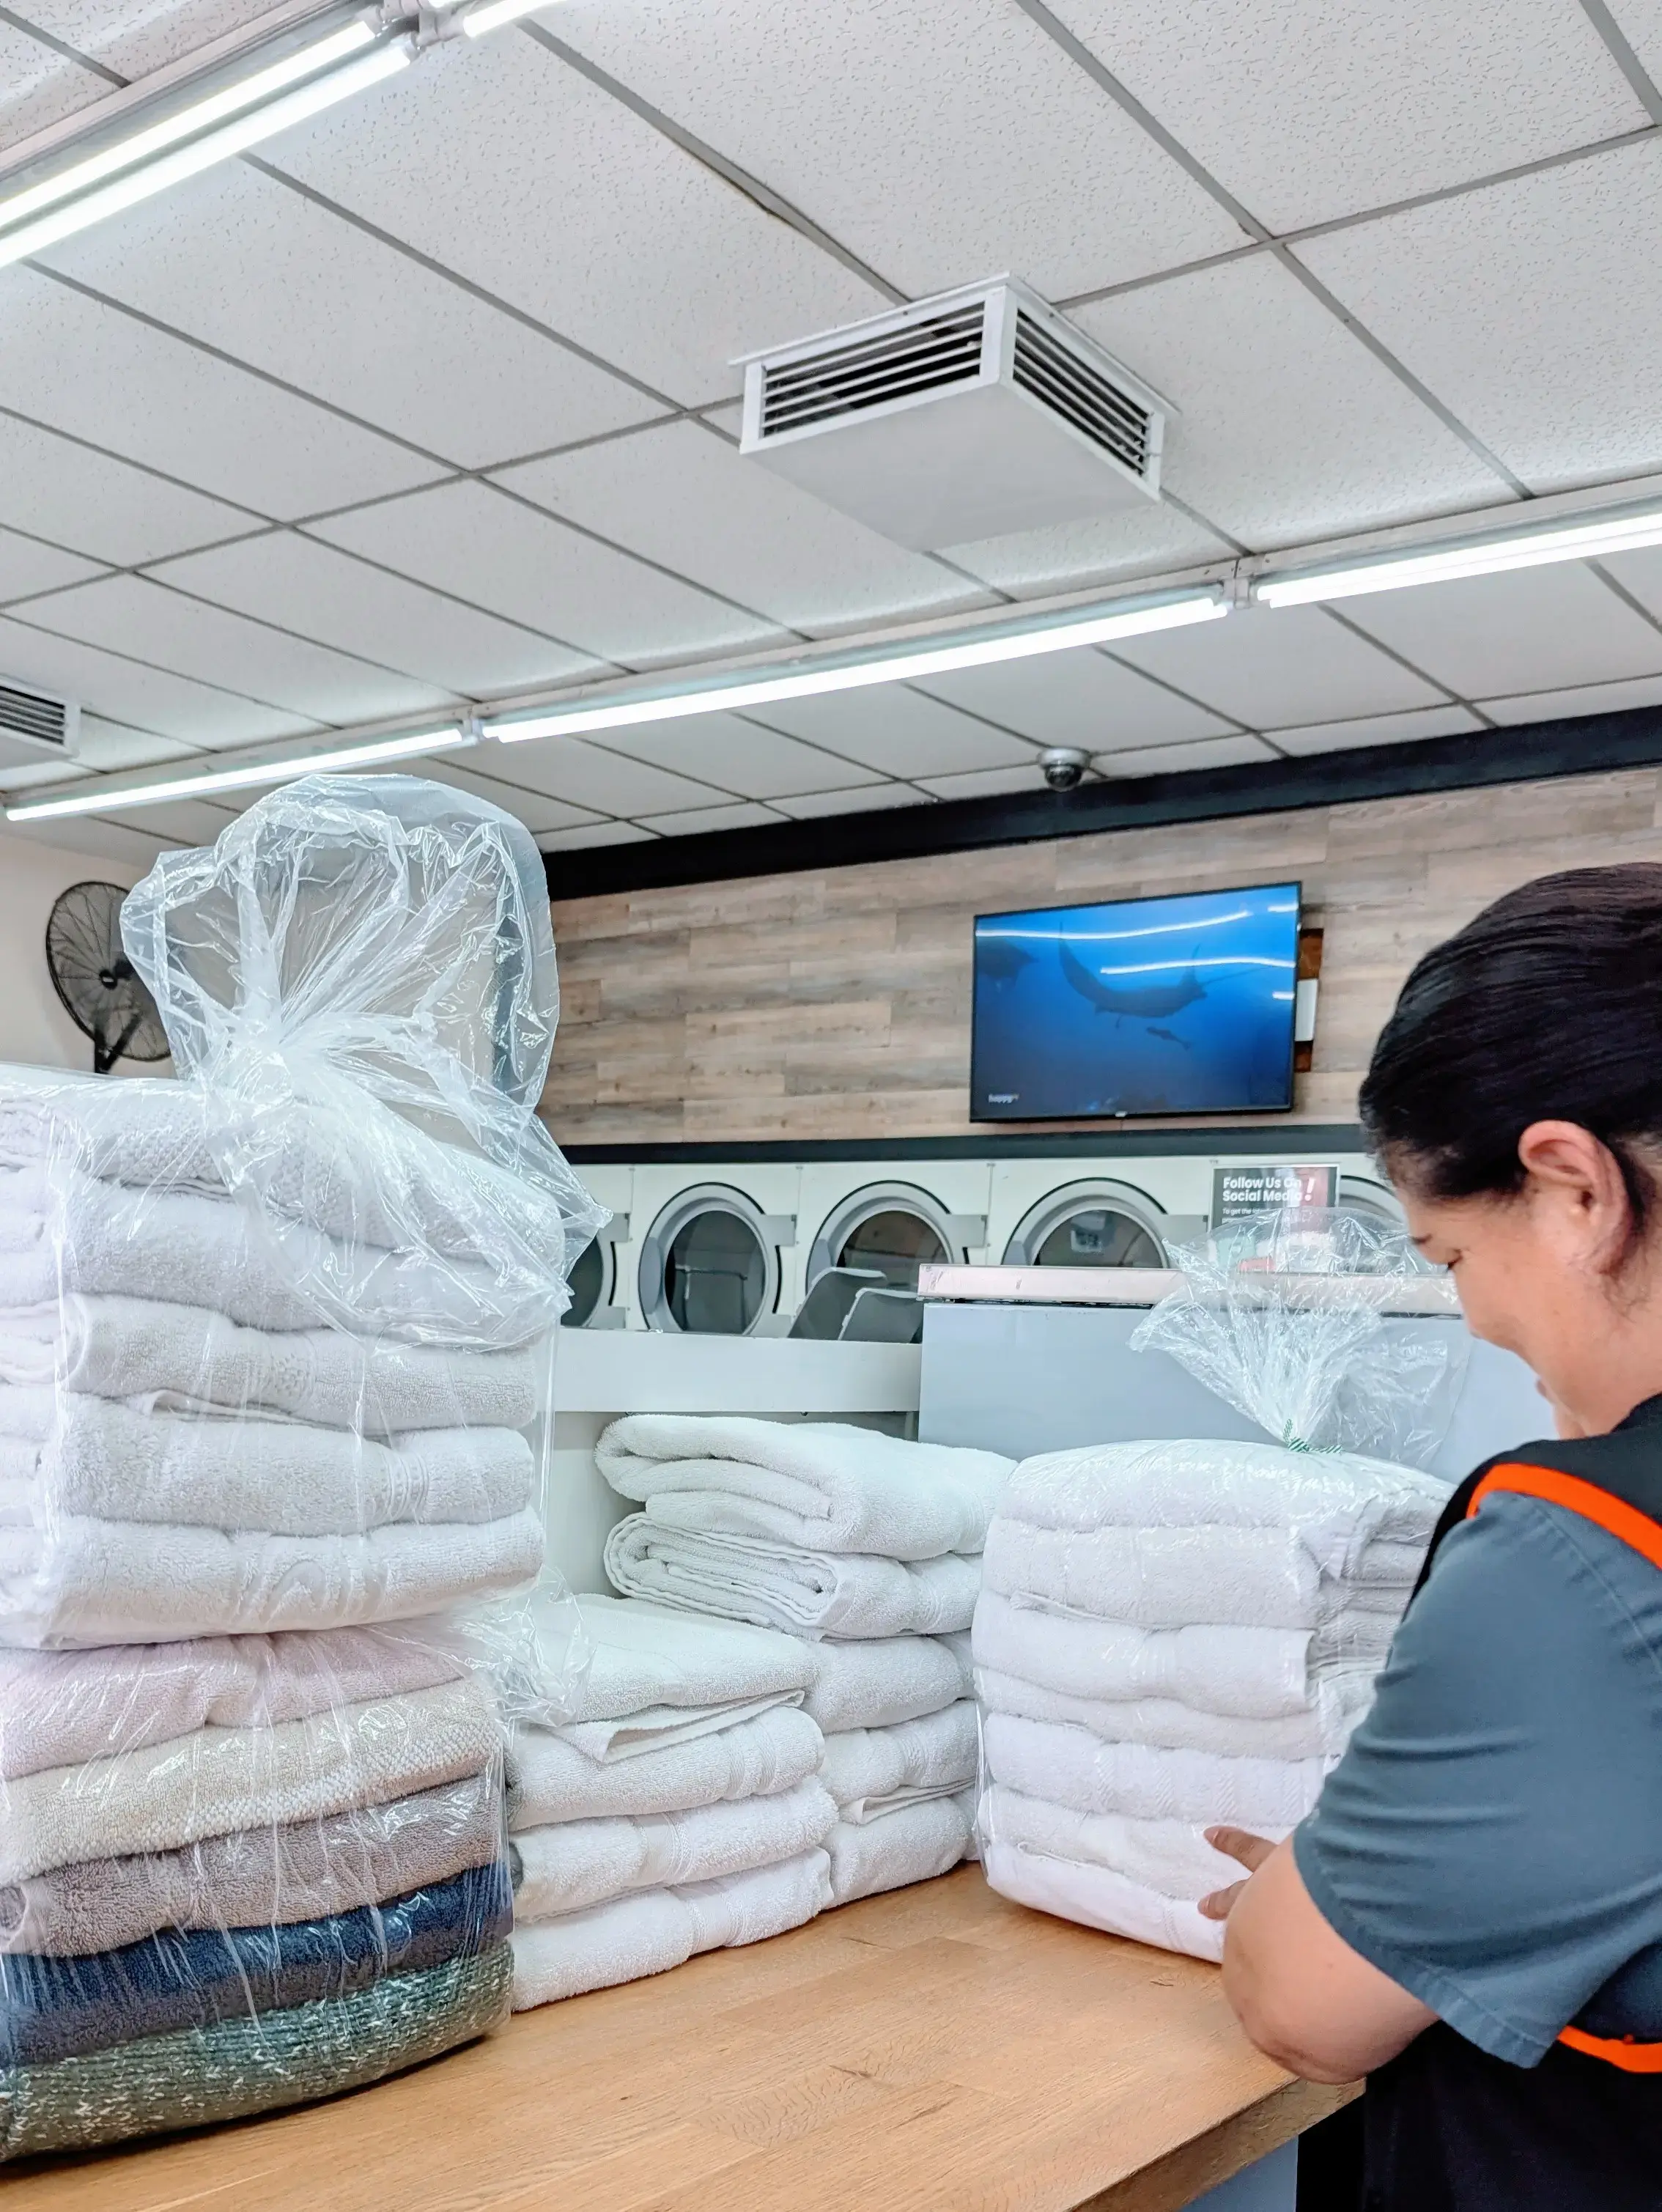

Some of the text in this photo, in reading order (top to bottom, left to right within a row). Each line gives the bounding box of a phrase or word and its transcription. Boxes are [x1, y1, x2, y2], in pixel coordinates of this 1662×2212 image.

[1223, 1177, 1301, 1189] Follow Us On
[1222, 1189, 1261, 1201] Social
[1230, 1208, 1241, 1216] get
